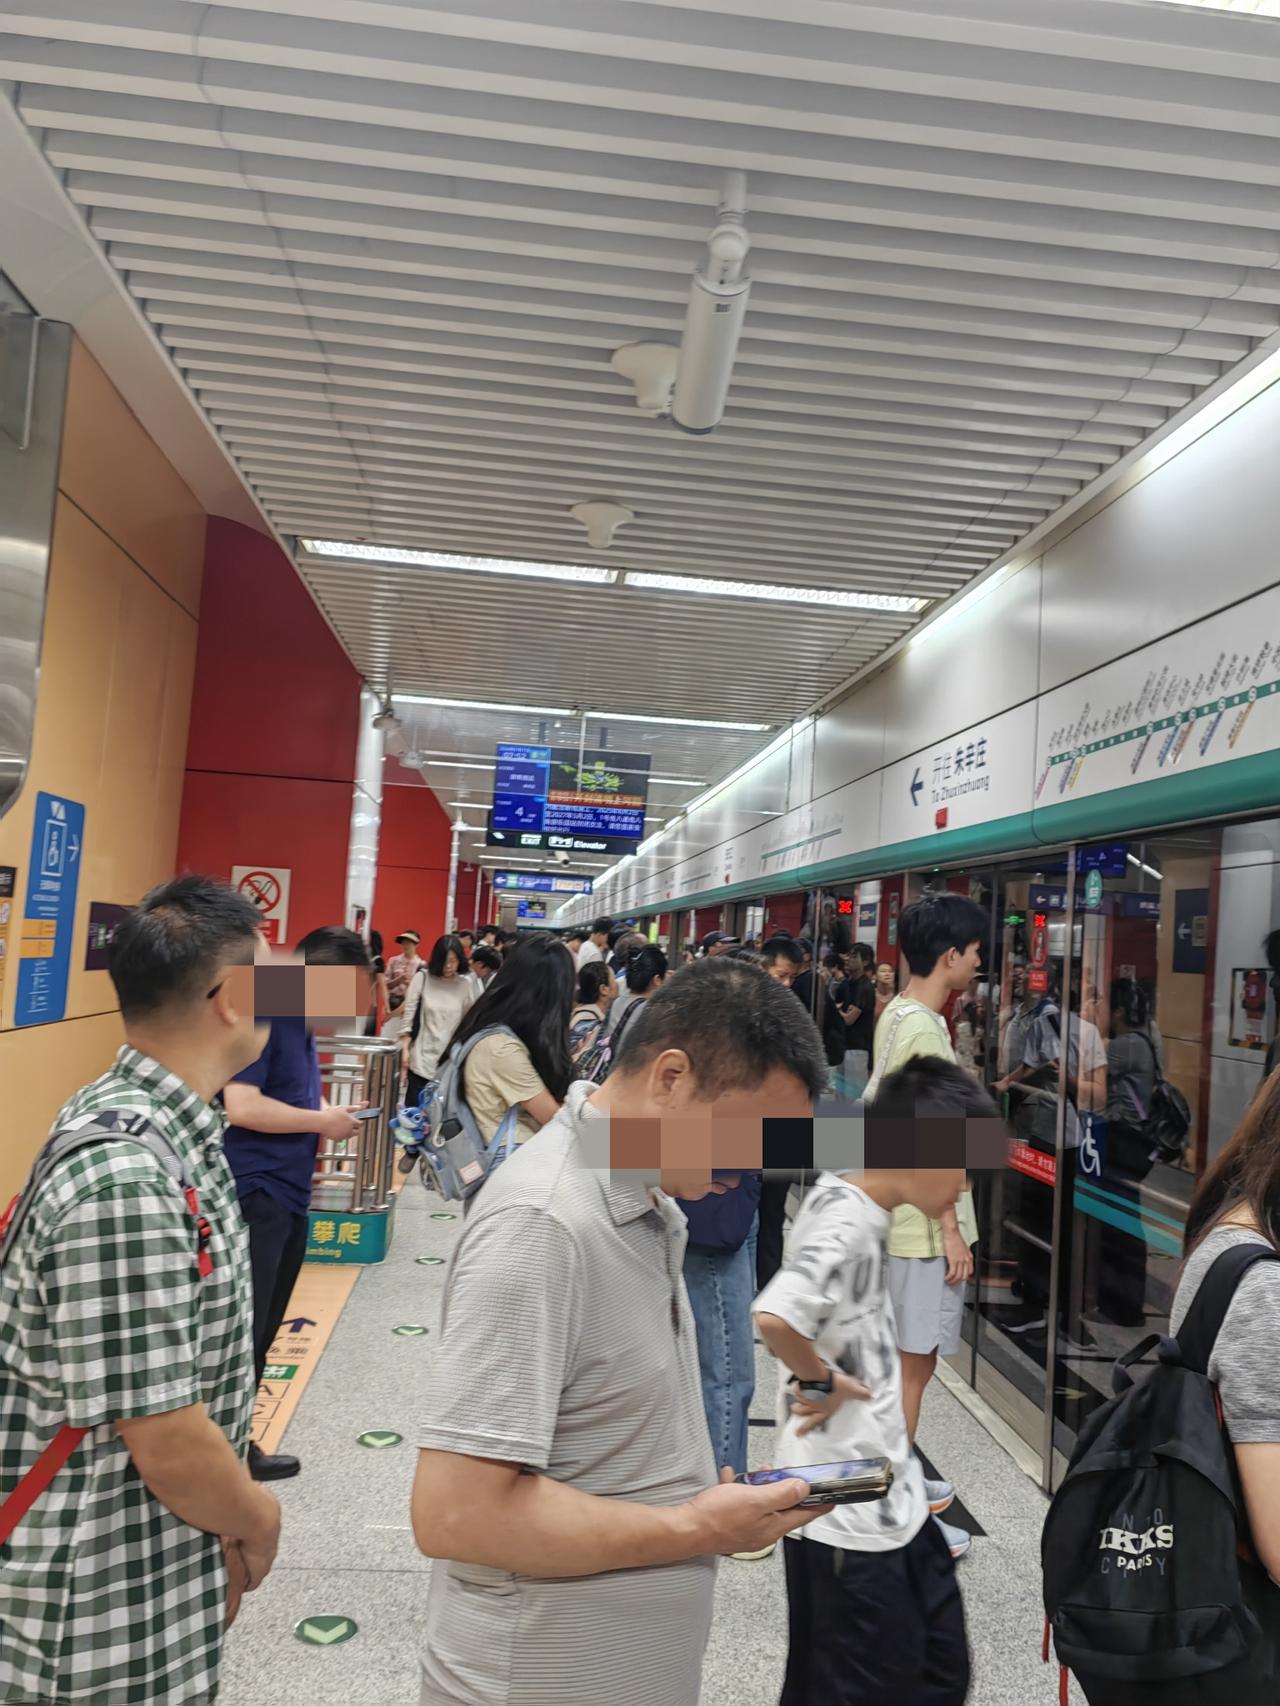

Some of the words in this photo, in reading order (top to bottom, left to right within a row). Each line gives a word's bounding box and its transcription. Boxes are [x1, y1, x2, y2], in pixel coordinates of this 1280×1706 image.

[933, 753, 952, 785] 开往
[954, 737, 987, 776] 朱辛庄
[932, 790, 939, 803] To
[941, 776, 990, 802] Zhuxinzhuang
[514, 806, 524, 817] 4
[573, 840, 607, 850] Elevator
[312, 1220, 361, 1244] 攀爬
[1117, 1554, 1153, 1570] PARIS
